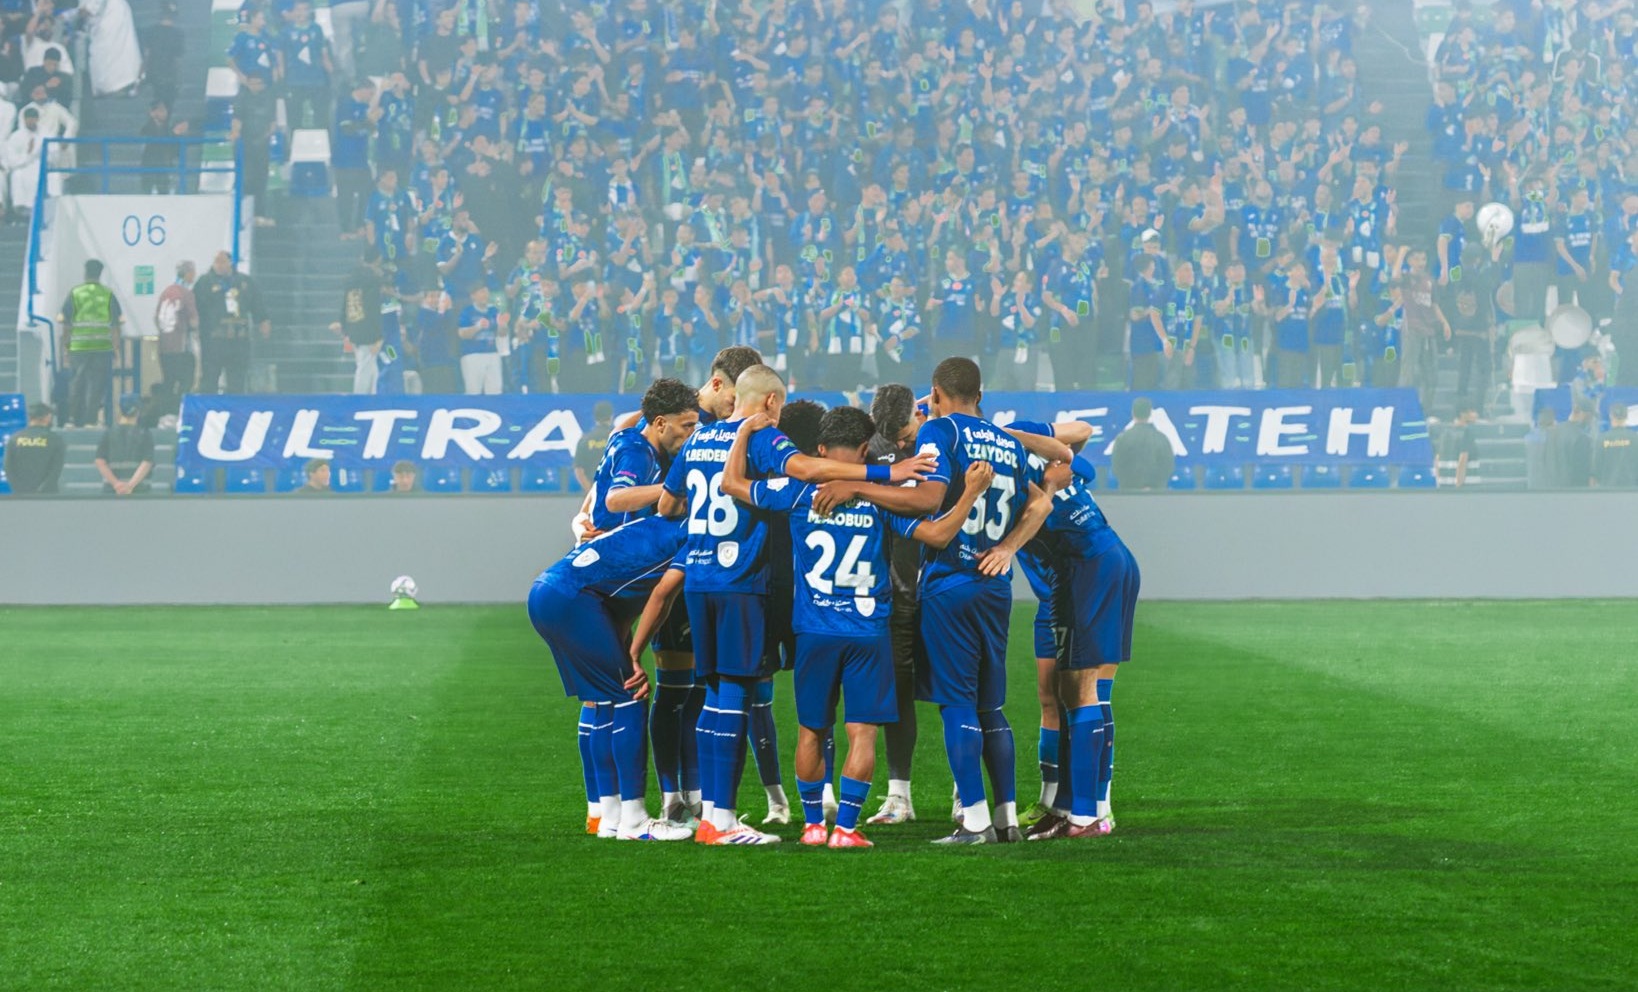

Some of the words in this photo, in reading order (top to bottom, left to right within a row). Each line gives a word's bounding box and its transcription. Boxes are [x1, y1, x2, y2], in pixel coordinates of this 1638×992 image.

[122, 215, 167, 247] 06
[198, 408, 642, 462] ULTRA
[686, 468, 739, 537] 28
[804, 529, 877, 596] 24
